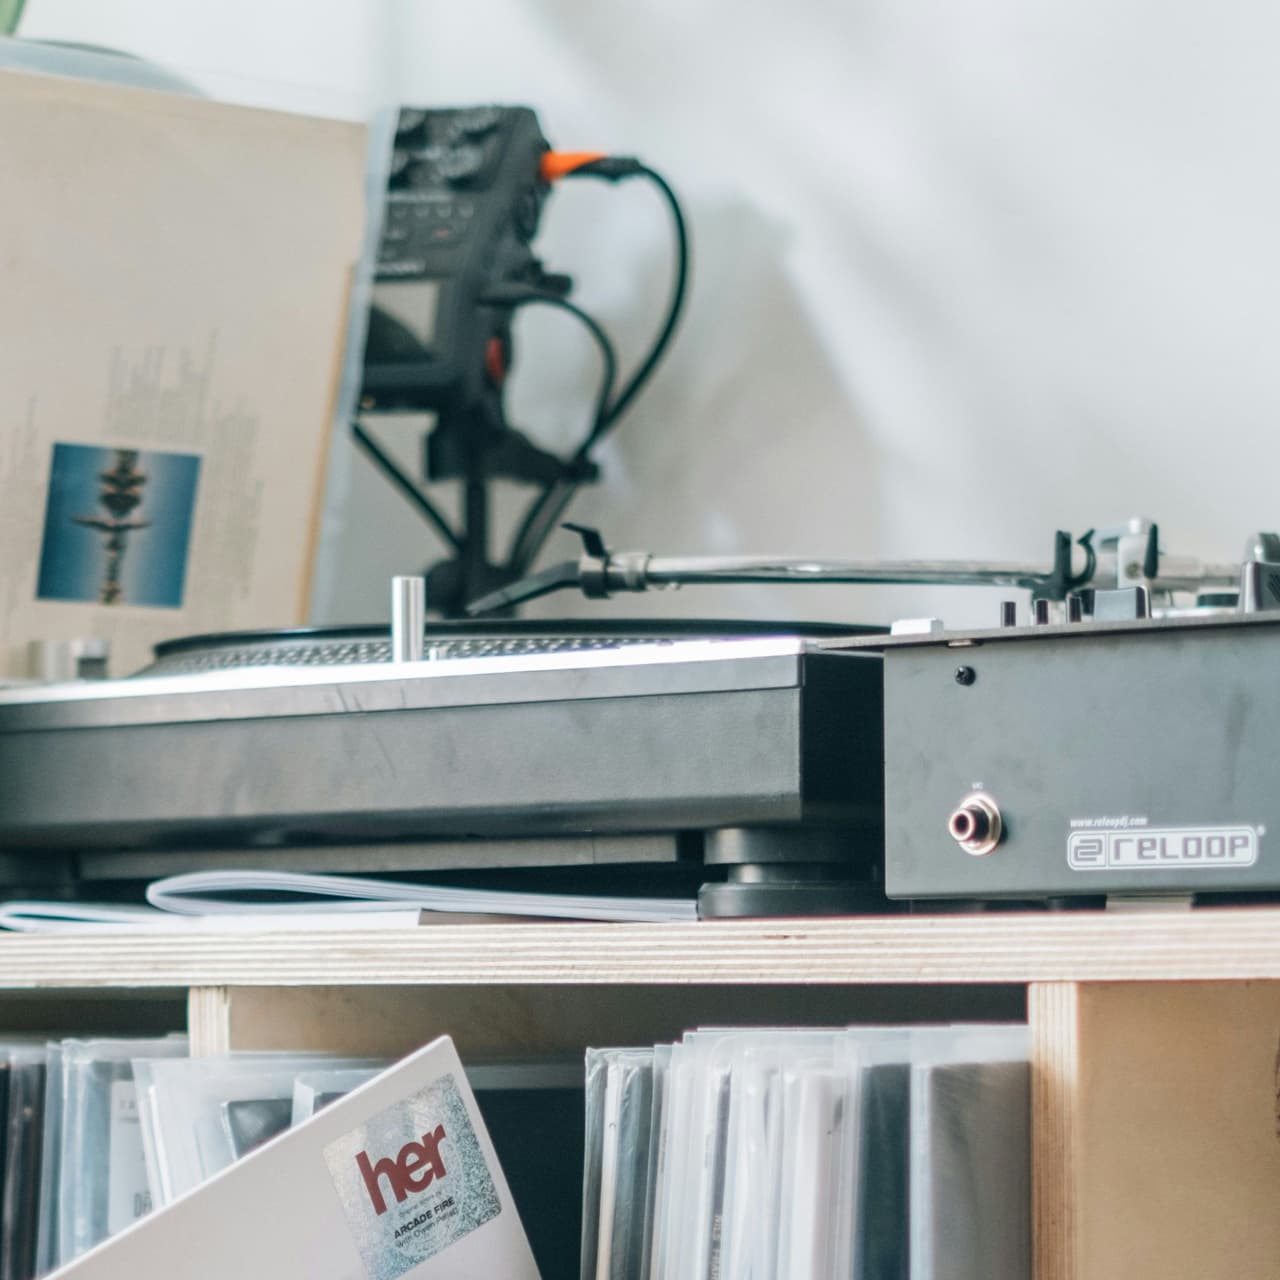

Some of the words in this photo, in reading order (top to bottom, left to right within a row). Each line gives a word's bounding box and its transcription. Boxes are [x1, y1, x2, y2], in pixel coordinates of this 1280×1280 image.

[355, 1124, 446, 1216] her
[394, 1210, 433, 1239] ARCADE
[434, 1196, 456, 1215] FIRE
